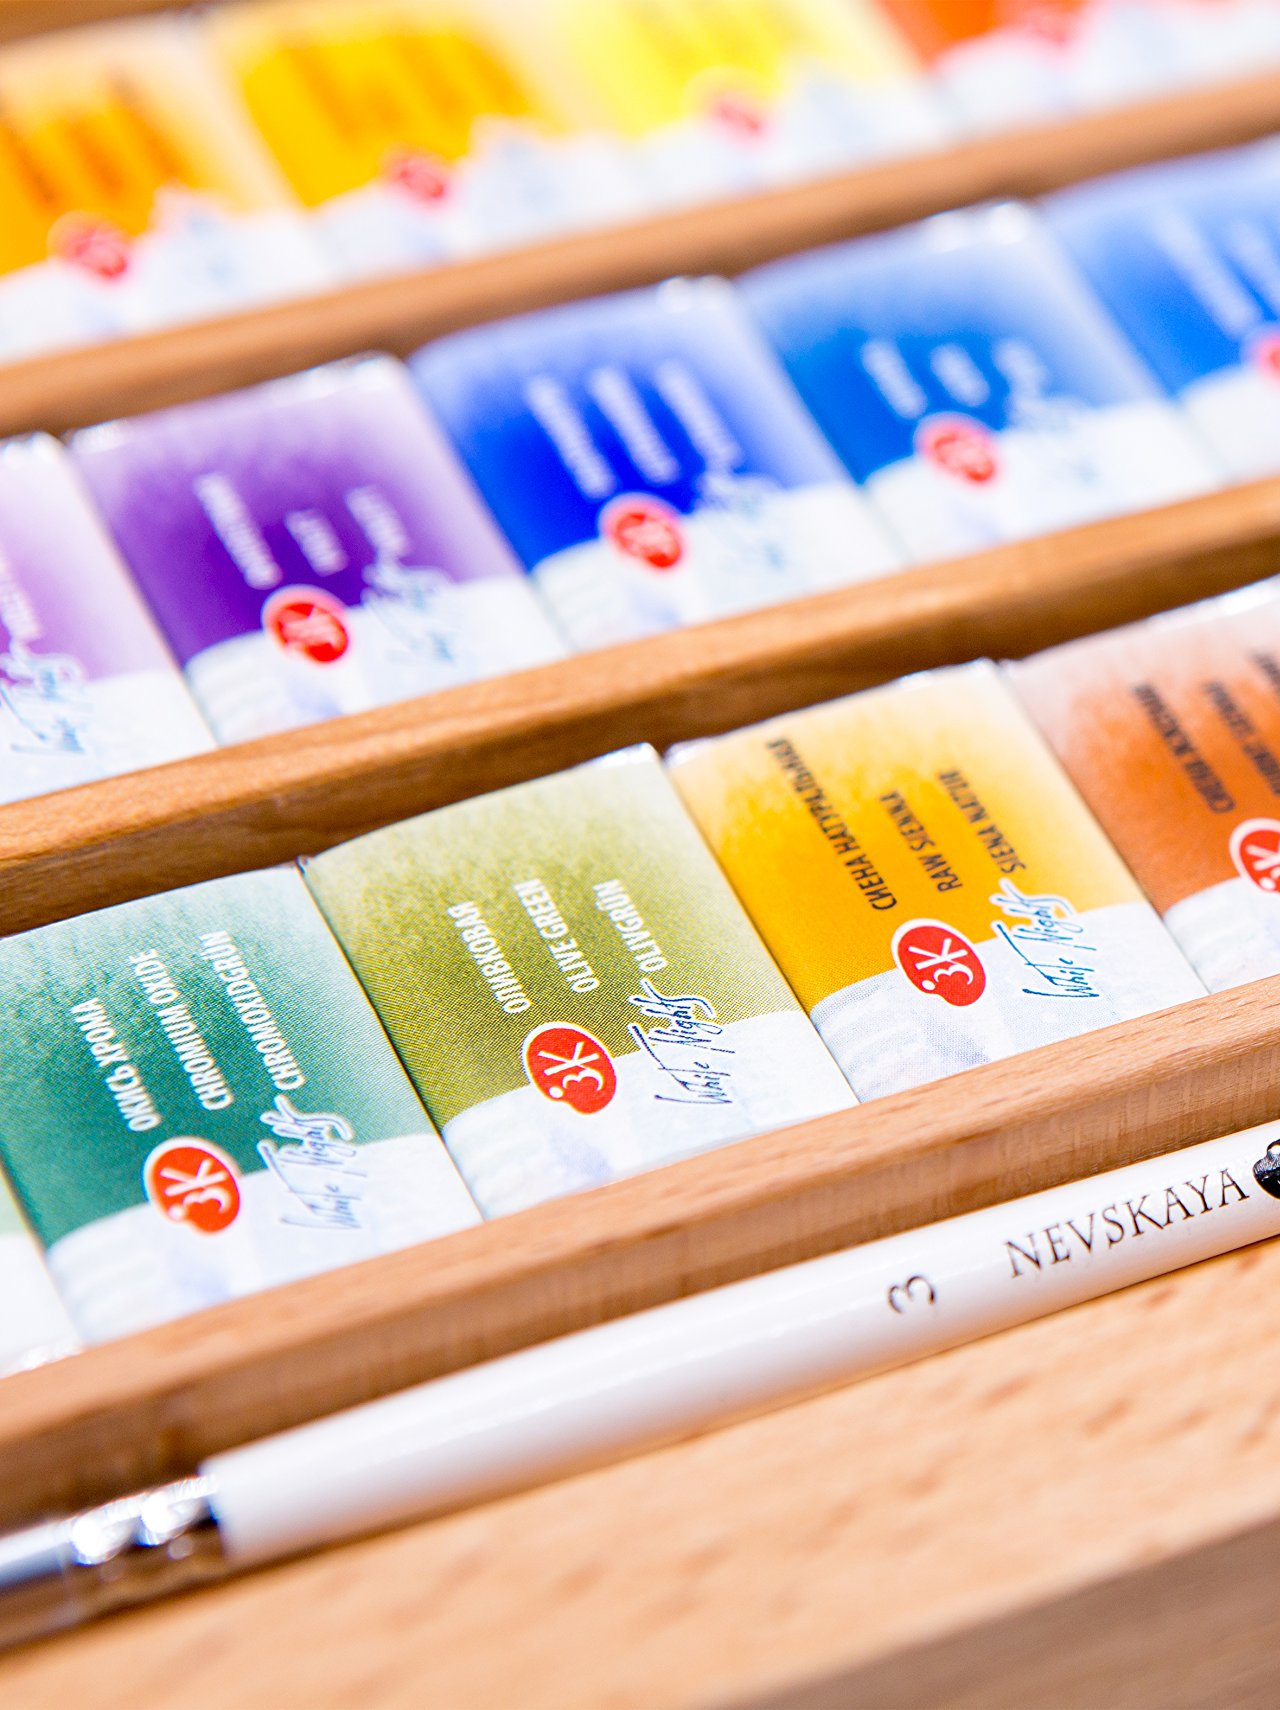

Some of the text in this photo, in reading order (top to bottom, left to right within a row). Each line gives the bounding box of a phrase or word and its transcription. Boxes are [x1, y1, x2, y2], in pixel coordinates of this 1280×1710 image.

[845, 854, 897, 911] СИЕНА
[879, 790, 964, 893] RAW SIENNA
[977, 823, 1027, 875] SIENA
[446, 900, 532, 1015] ОЛИВКОВАЯ
[511, 878, 601, 994] OLIVE GREEN
[592, 878, 668, 974] OLIVGRÜN
[70, 997, 161, 1132] ОКИСЬ ХРОМА
[129, 948, 234, 1111] CHROMIUM OXIDE
[198, 929, 306, 1091] CHROMOXIDGRÜN
[887, 1274, 937, 1315] 3
[1003, 1168, 1251, 1279] NEVSKAYA
